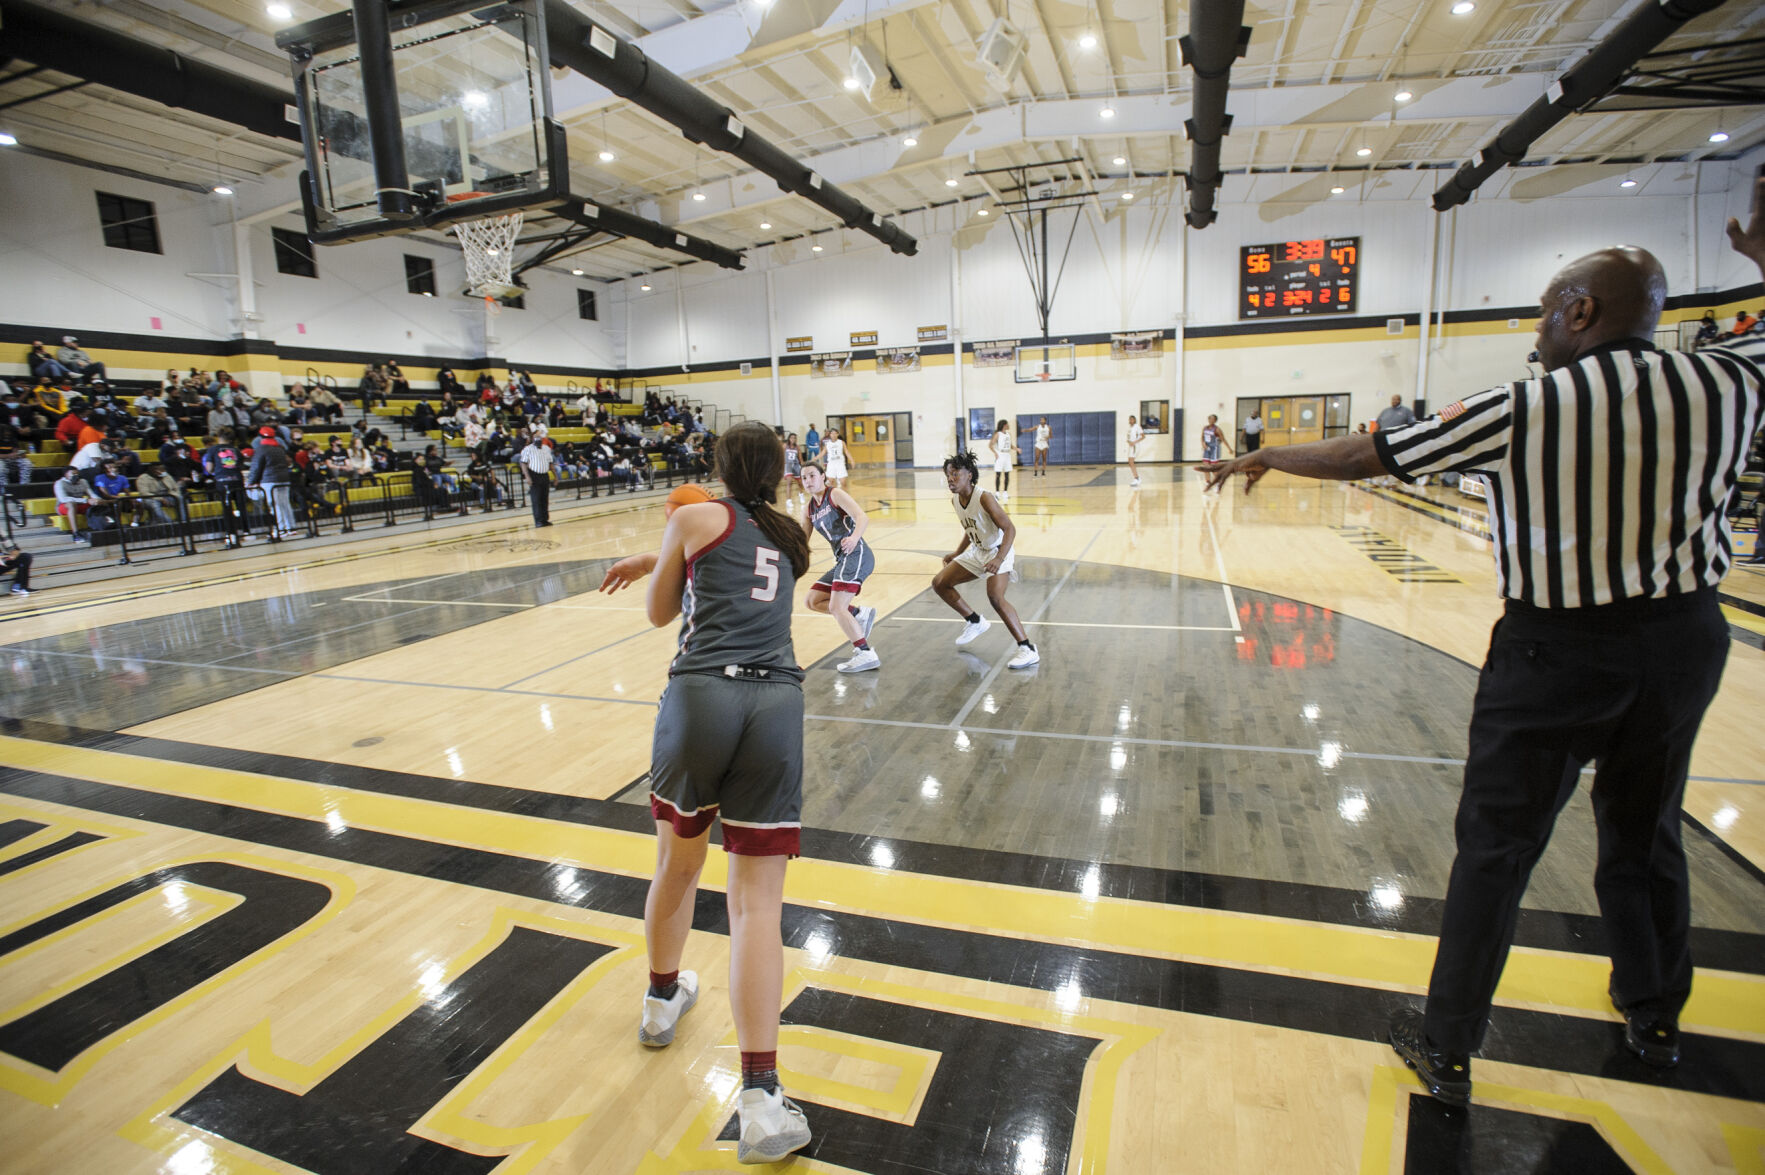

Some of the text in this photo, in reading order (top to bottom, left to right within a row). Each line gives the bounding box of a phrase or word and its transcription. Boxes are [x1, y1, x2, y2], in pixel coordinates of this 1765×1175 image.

[1247, 254, 1271, 273] 56
[1330, 247, 1356, 265] 47
[1308, 264, 1320, 277] 4
[1248, 294, 1260, 307] 4
[1264, 292, 1276, 307] 2
[1319, 288, 1331, 303] 2
[1338, 287, 1351, 302] 6
[750, 545, 780, 602] 5
